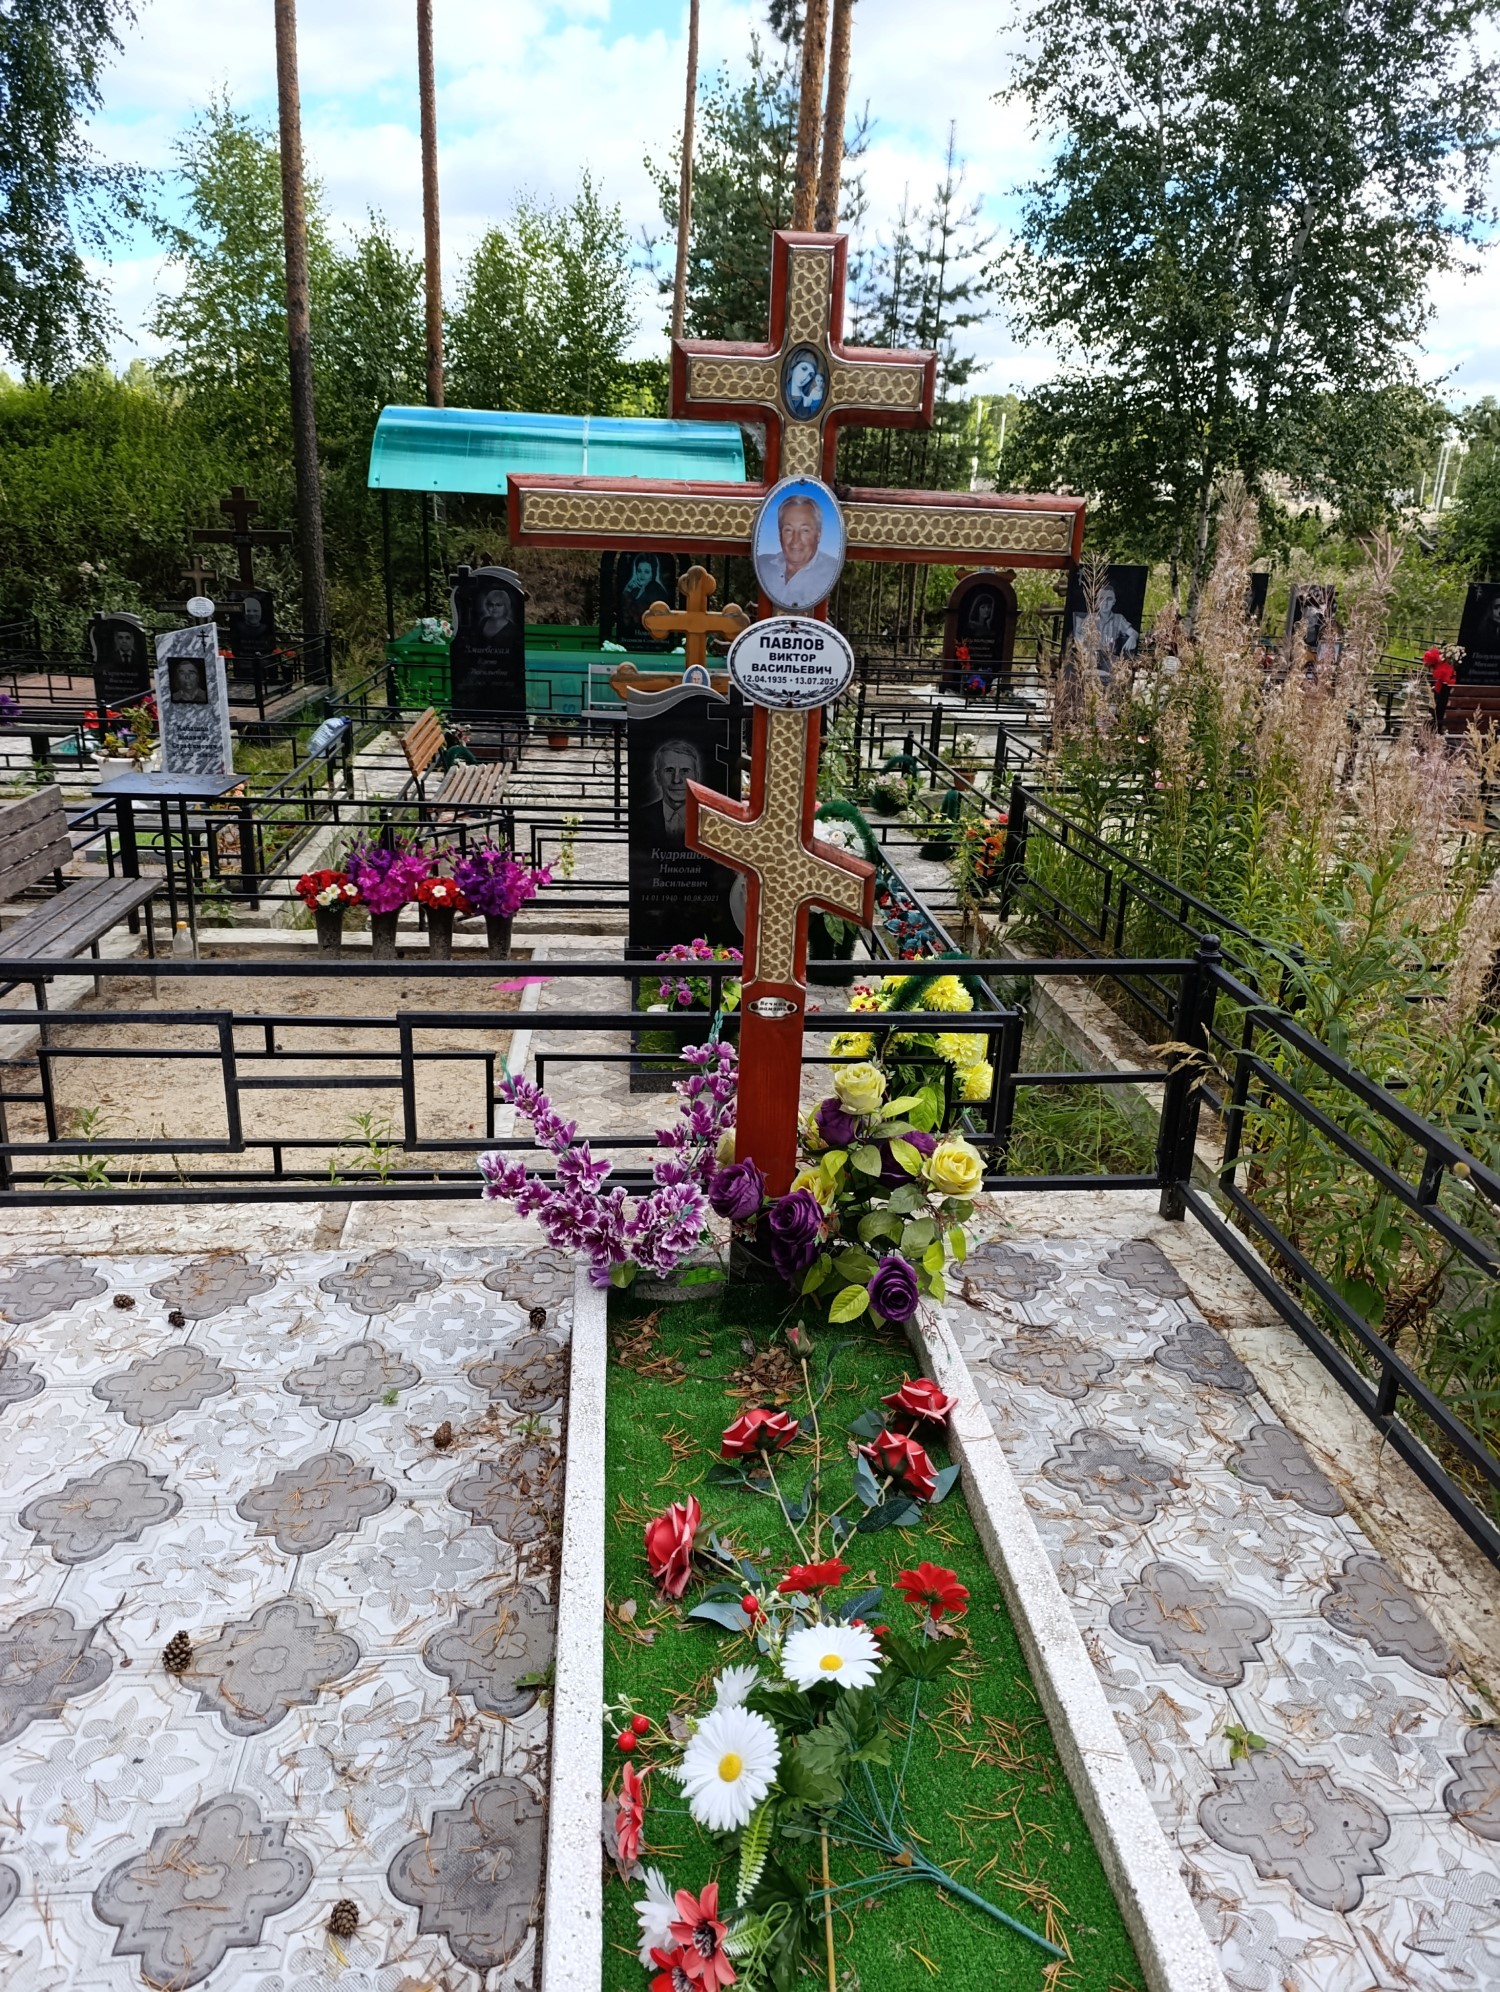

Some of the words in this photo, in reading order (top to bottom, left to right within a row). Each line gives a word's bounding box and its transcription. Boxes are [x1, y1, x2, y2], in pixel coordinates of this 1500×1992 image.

[760, 637, 824, 650] ПАВЛОВ
[769, 652, 816, 662] ВИКТОР
[751, 663, 832, 675] ВАСИЛЬЕВИЧ
[742, 675, 787, 684] 12.04.1935
[794, 677, 839, 686] 13.07.2021
[659, 864, 701, 874] Николай
[652, 878, 708, 888] Васильевич
